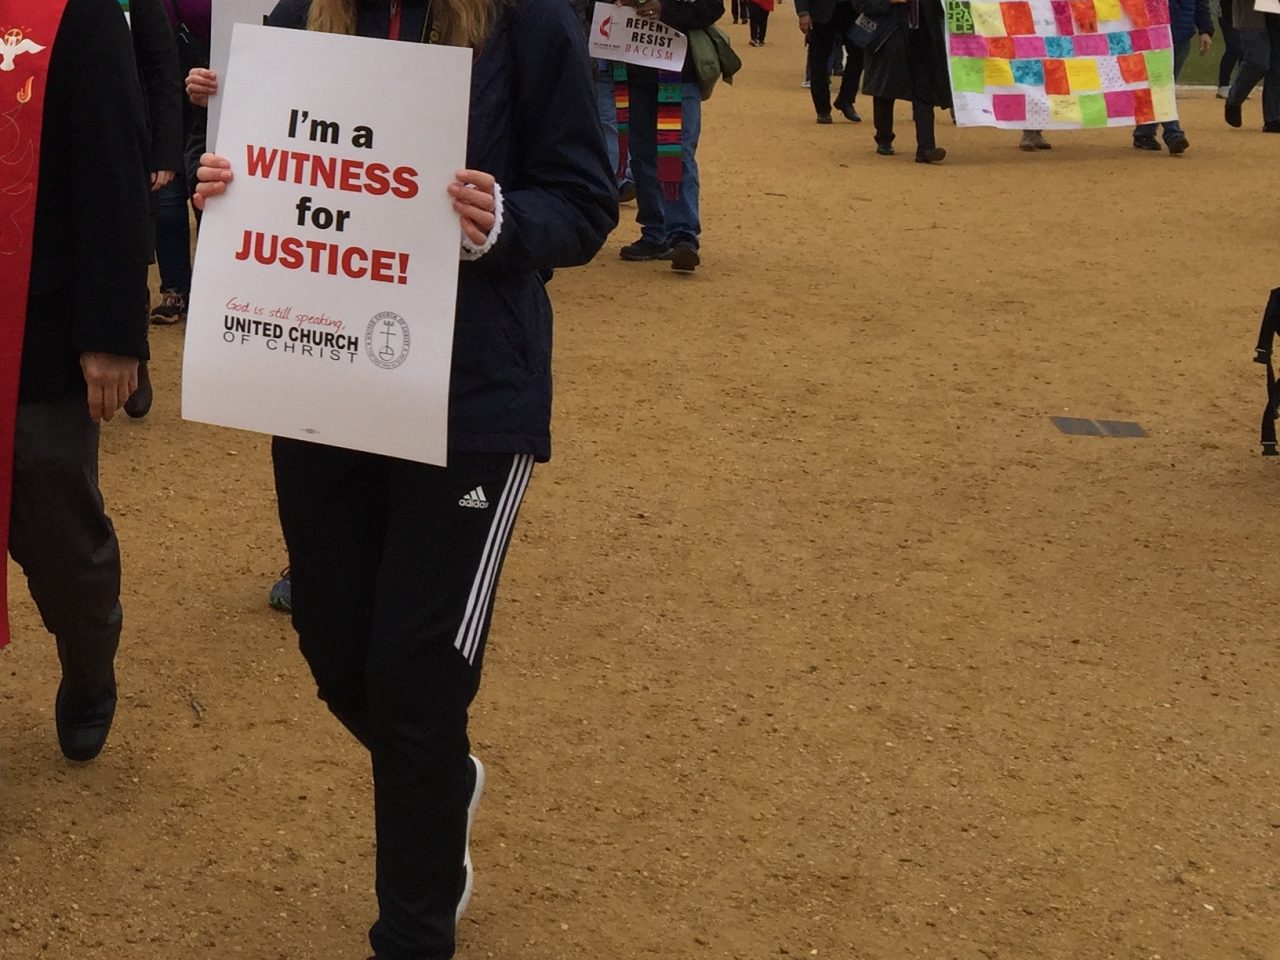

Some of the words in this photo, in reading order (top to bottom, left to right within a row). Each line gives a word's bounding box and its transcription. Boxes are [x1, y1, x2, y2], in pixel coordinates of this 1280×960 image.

[626, 17, 670, 35] REPENT
[631, 31, 674, 48] RESIST
[624, 44, 674, 61] RACISM
[287, 109, 340, 145] I'm
[351, 125, 374, 149] a
[246, 144, 419, 199] WITNESS
[295, 196, 351, 232] for
[235, 230, 410, 285] JUSTICE!
[225, 297, 250, 313] God
[253, 307, 264, 315] is
[270, 306, 292, 320] still
[223, 331, 251, 345] OF
[266, 339, 358, 364] CHRIST
[224, 315, 283, 339] UNITED
[288, 326, 359, 352] CHURCH
